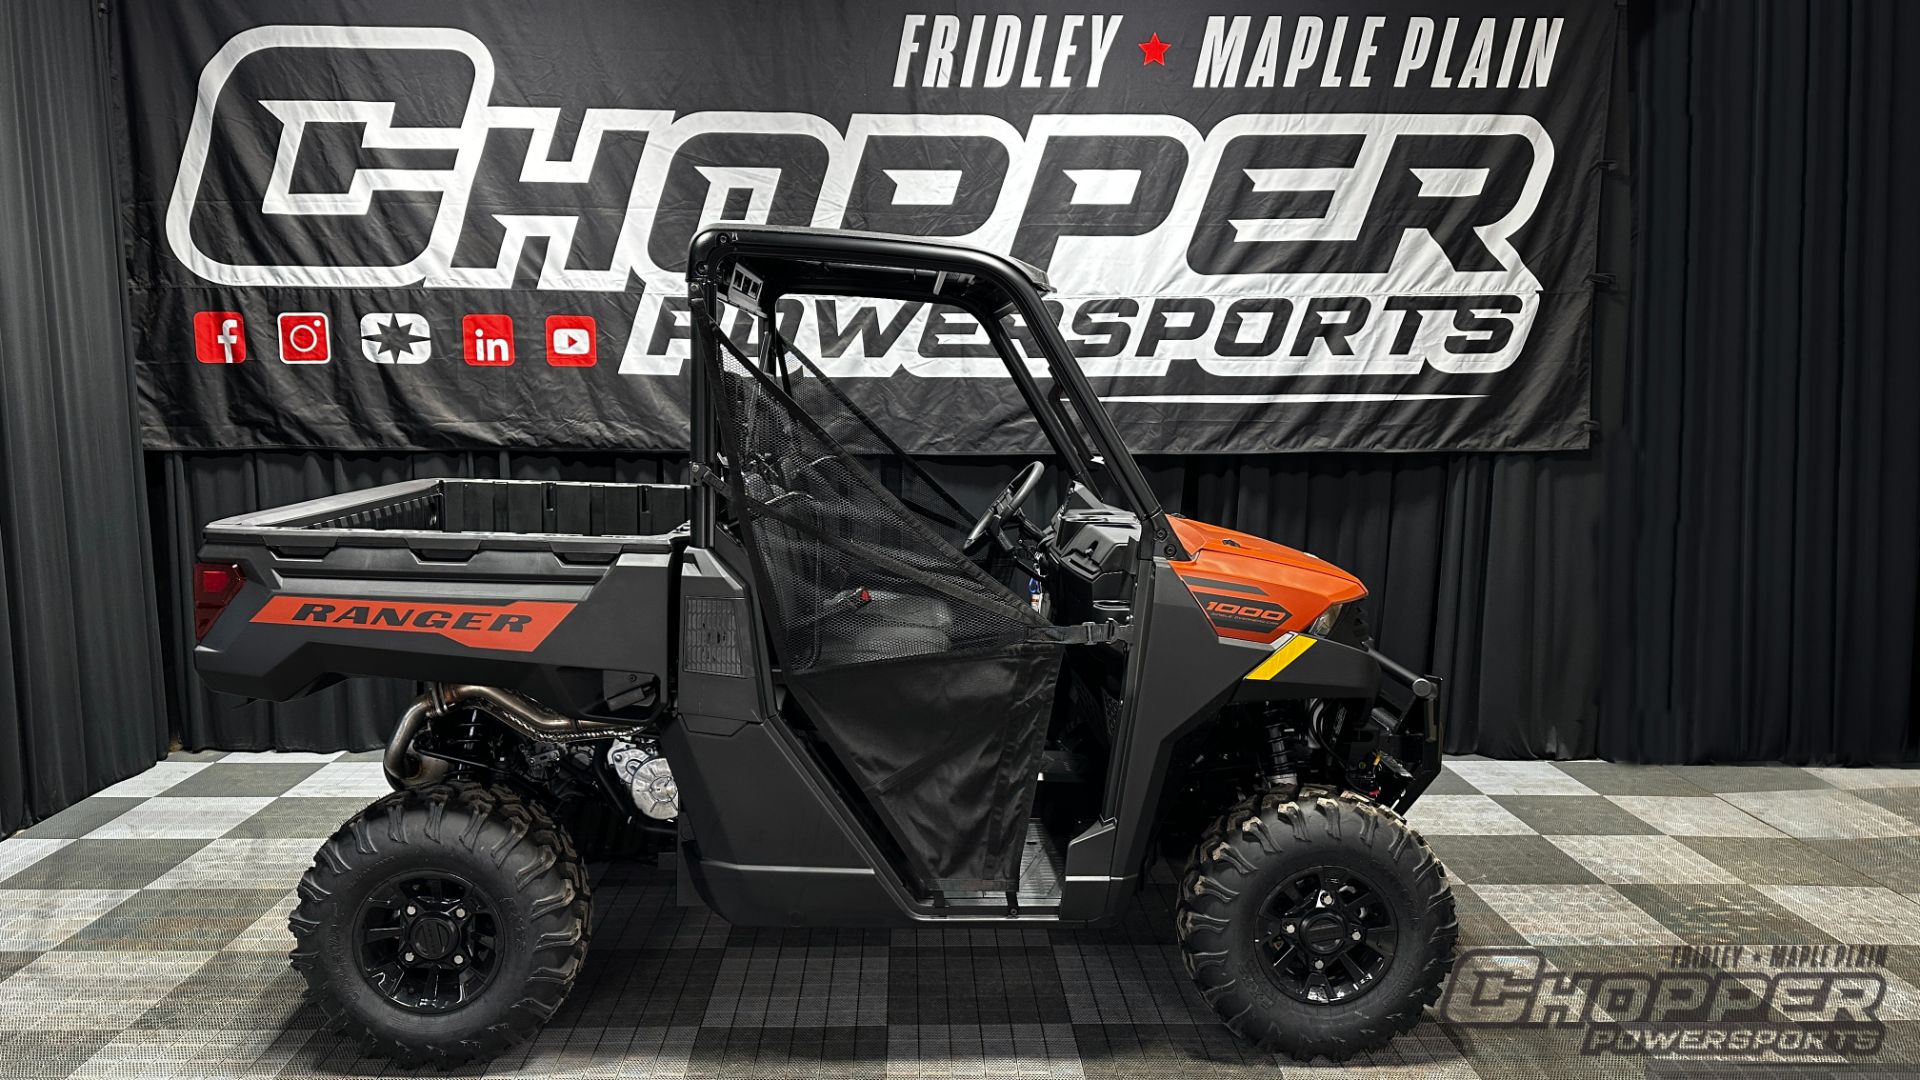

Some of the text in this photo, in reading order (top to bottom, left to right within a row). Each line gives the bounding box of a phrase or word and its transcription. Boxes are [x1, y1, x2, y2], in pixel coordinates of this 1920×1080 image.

[892, 14, 1565, 89] FRIDLEY MAPLE PLAIN
[170, 30, 1550, 288] CHOPPER
[291, 603, 533, 633] RANGER
[1206, 601, 1287, 621] 1000
